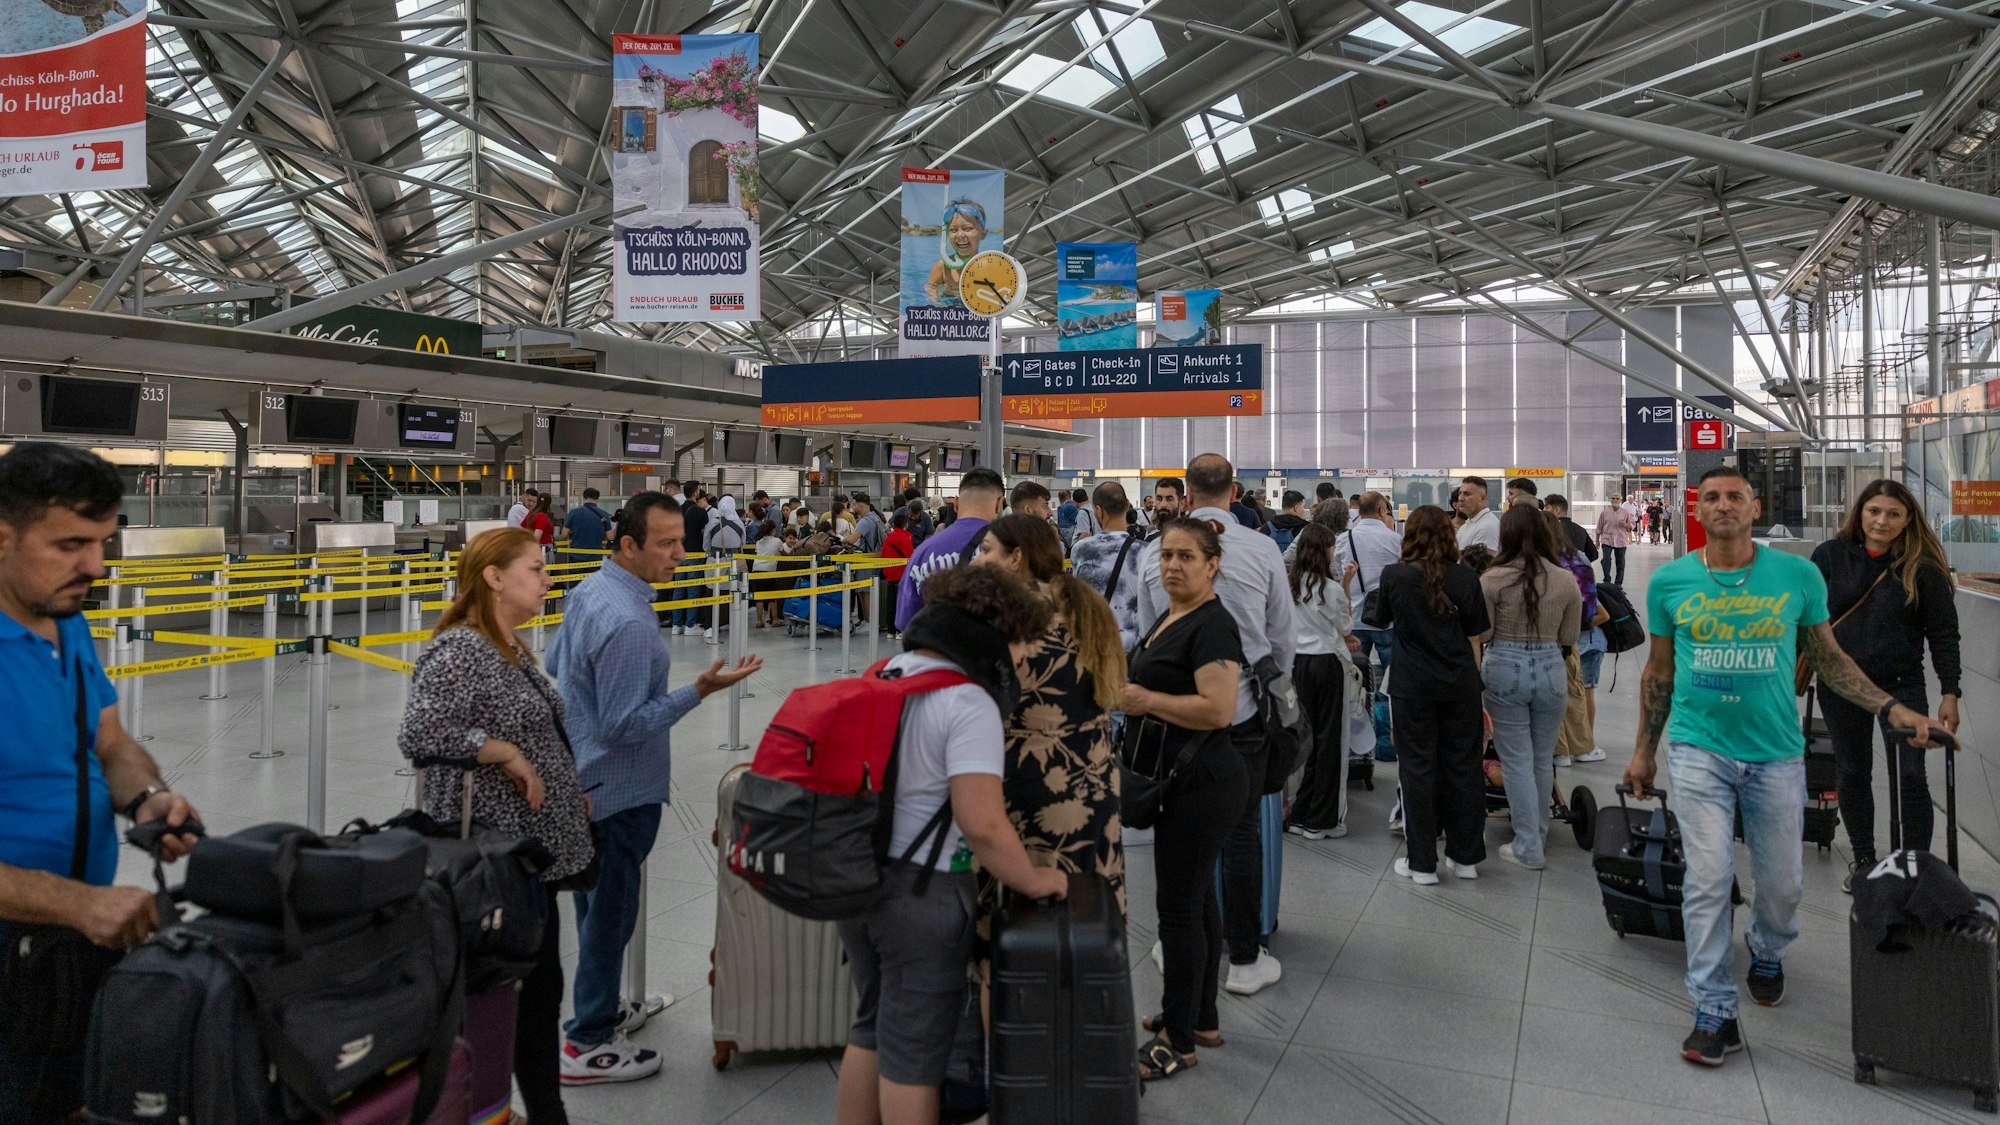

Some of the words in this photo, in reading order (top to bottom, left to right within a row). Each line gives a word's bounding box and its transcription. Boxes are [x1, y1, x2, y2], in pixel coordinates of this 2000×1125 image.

[0, 73, 34, 87] chüss
[38, 69, 100, 84] Köln-Bonn.
[25, 84, 124, 115] Hurghada!
[15, 151, 60, 162] URLAUB
[628, 231, 673, 247] TSCHÜSS
[676, 231, 746, 247] KÖLN-BONN.
[632, 252, 677, 271] HALLO
[682, 252, 742, 271] RHODOS!
[710, 296, 744, 304] BUCHER
[909, 308, 941, 320] TSCHÜSS
[907, 324, 937, 337] HALLO
[1044, 360, 1076, 370] Gates
[1092, 358, 1141, 369] Check-in
[1184, 355, 1231, 367] Ankunft
[1236, 354, 1242, 365] 1
[1045, 376, 1051, 387] B
[1055, 376, 1062, 387] C
[1067, 376, 1073, 386] D
[1091, 374, 1137, 386] 101-220
[1184, 372, 1229, 384] Arrivals
[1236, 371, 1242, 383] 1
[142, 388, 164, 401] 313
[265, 397, 284, 410] 312
[459, 411, 472, 422] 311
[537, 417, 549, 428] 310
[1676, 589, 1790, 625] Original
[1692, 613, 1735, 641] On
[1694, 647, 1776, 668] BROOKLYN
[154, 663, 174, 671] Airport
[1694, 674, 1732, 688] DENIM
